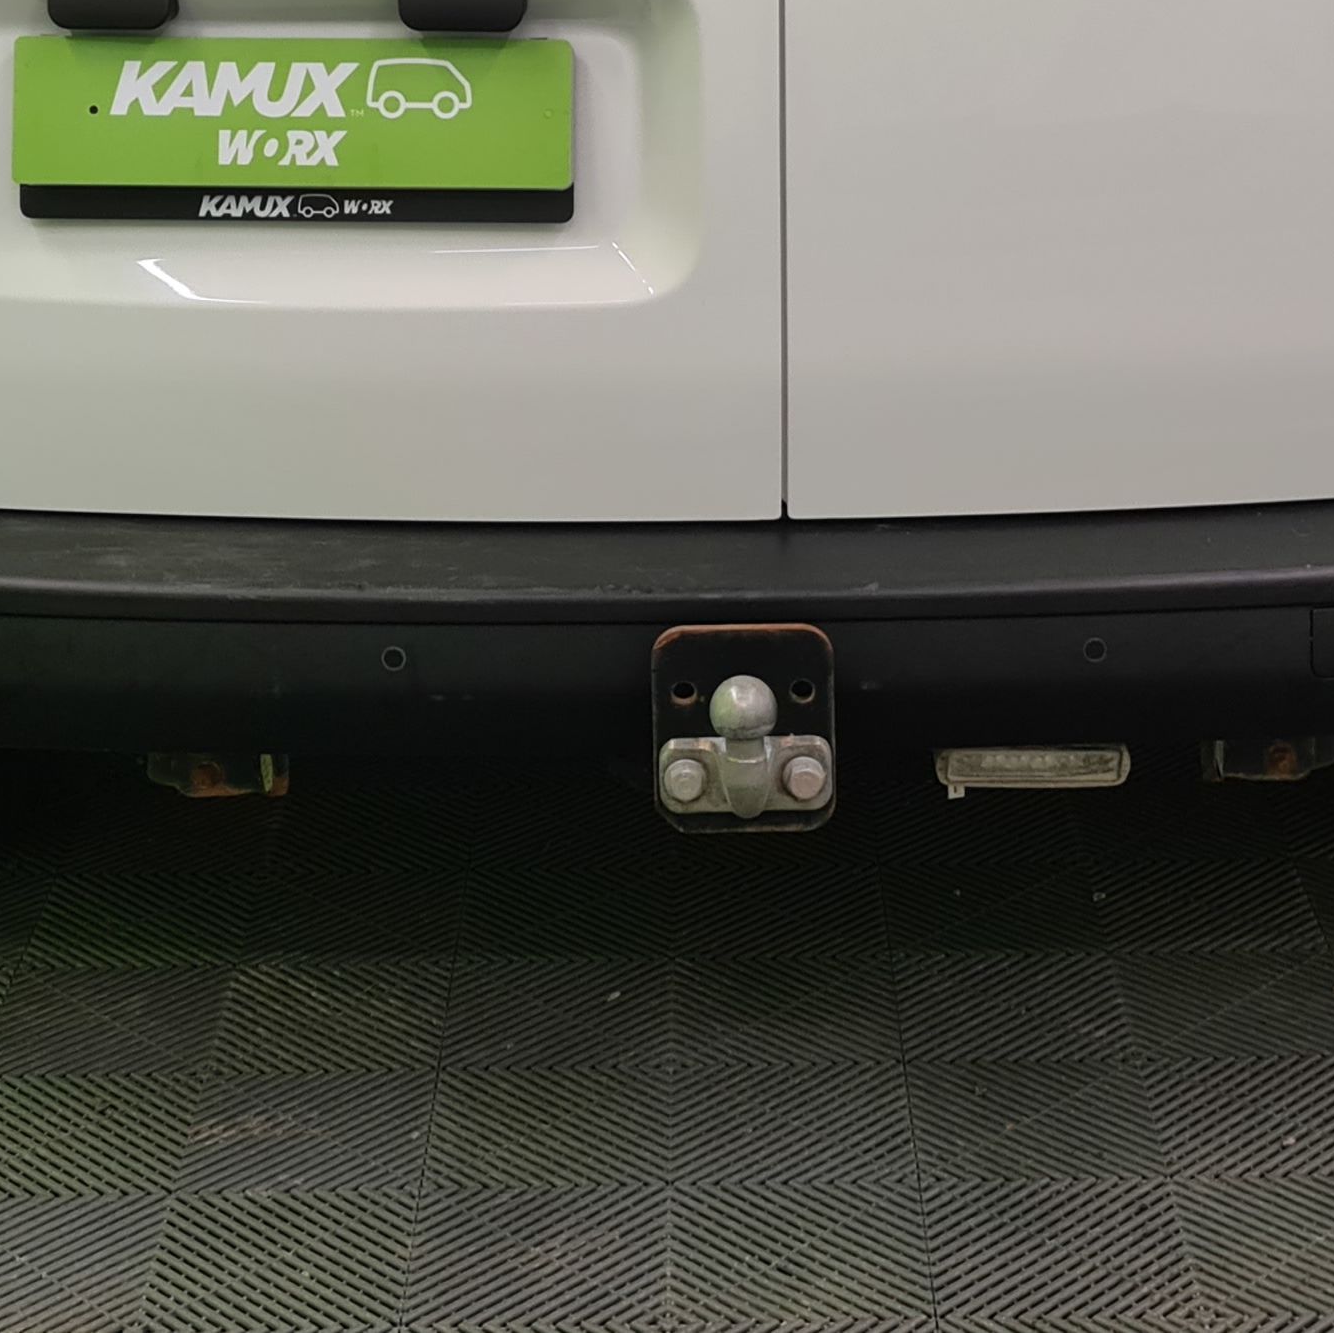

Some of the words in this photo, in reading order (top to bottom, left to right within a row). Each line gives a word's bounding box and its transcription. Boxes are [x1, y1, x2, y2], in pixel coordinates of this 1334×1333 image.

[109, 60, 360, 118] KAMUX
[218, 129, 348, 167] WORX
[198, 195, 295, 218] KAMUX
[343, 199, 394, 215] WORX
